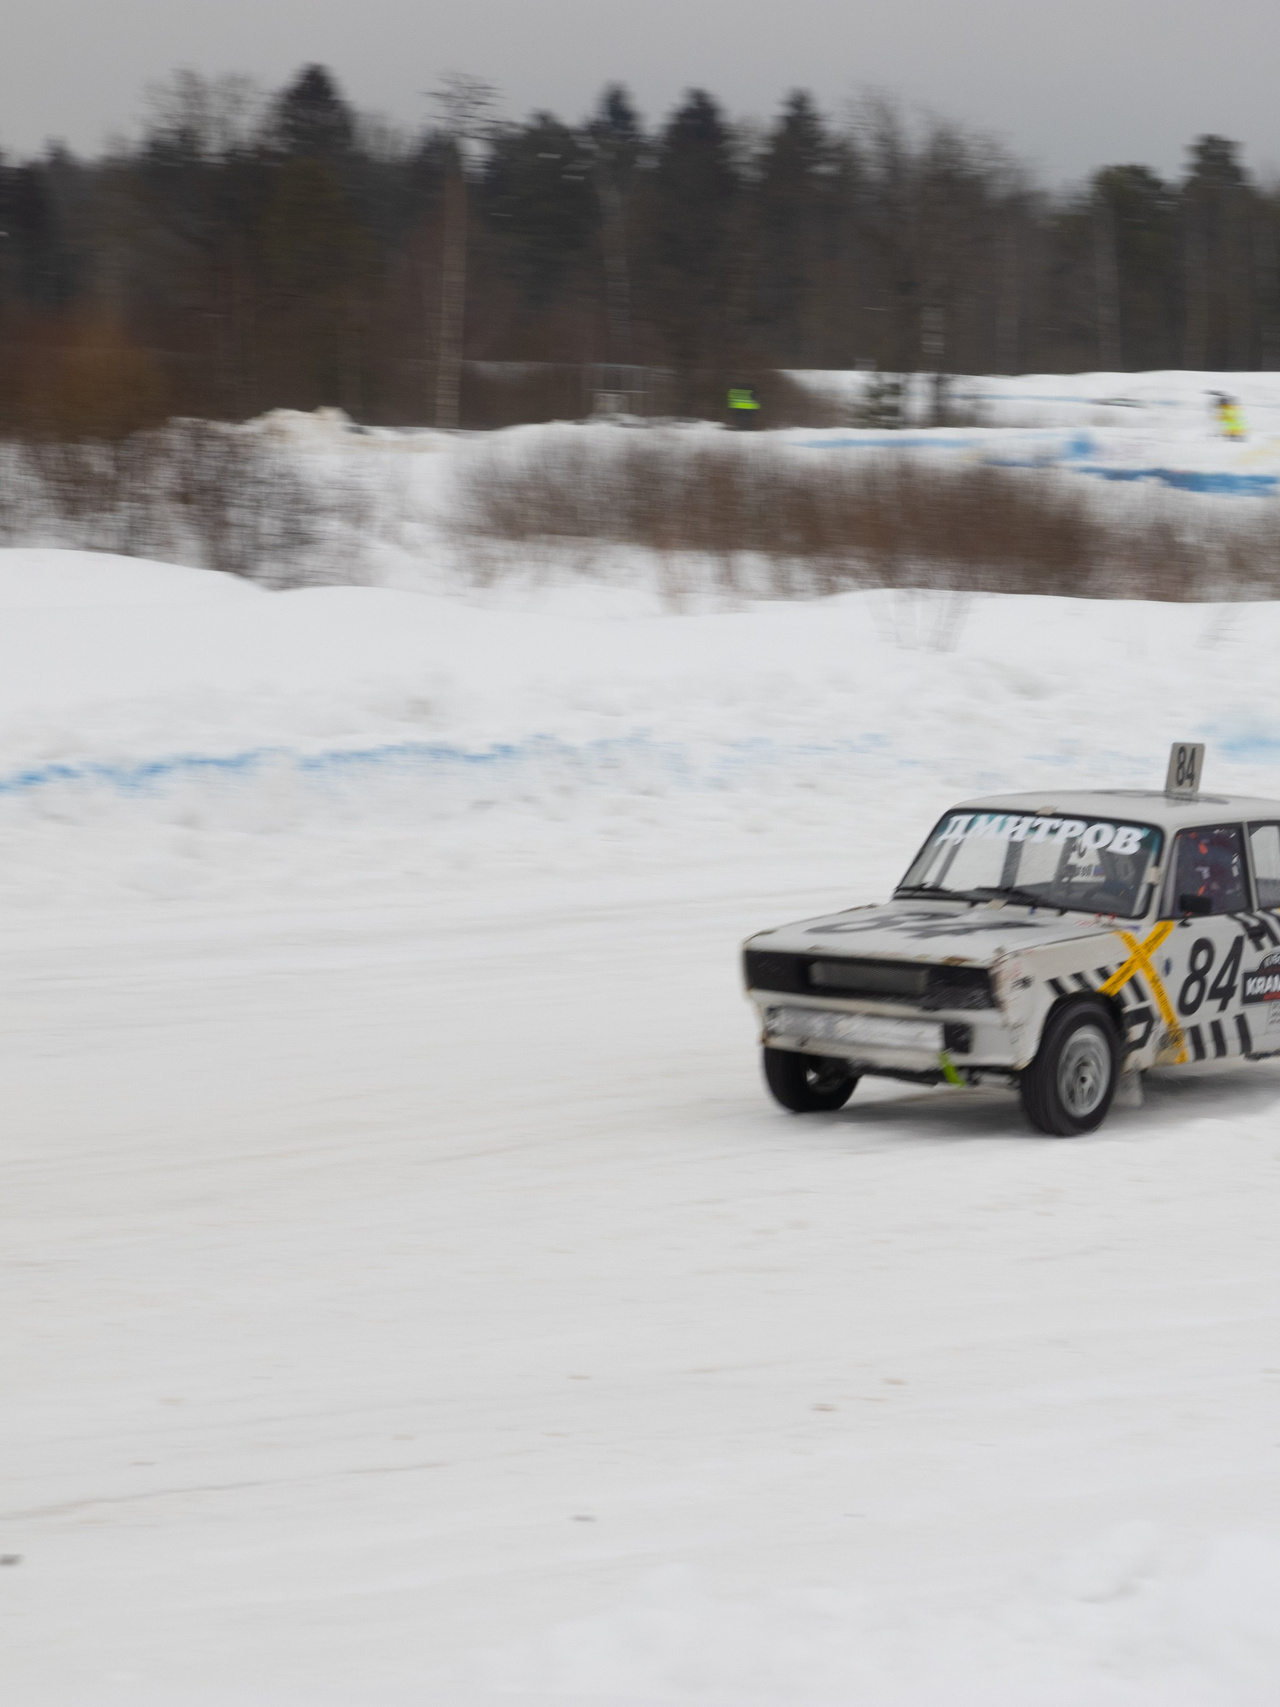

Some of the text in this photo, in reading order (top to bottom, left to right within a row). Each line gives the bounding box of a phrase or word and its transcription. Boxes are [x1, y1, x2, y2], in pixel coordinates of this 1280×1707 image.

[1176, 745, 1196, 787] 84
[934, 813, 1144, 855] ДМИТРОВ
[1178, 935, 1245, 1016] 84
